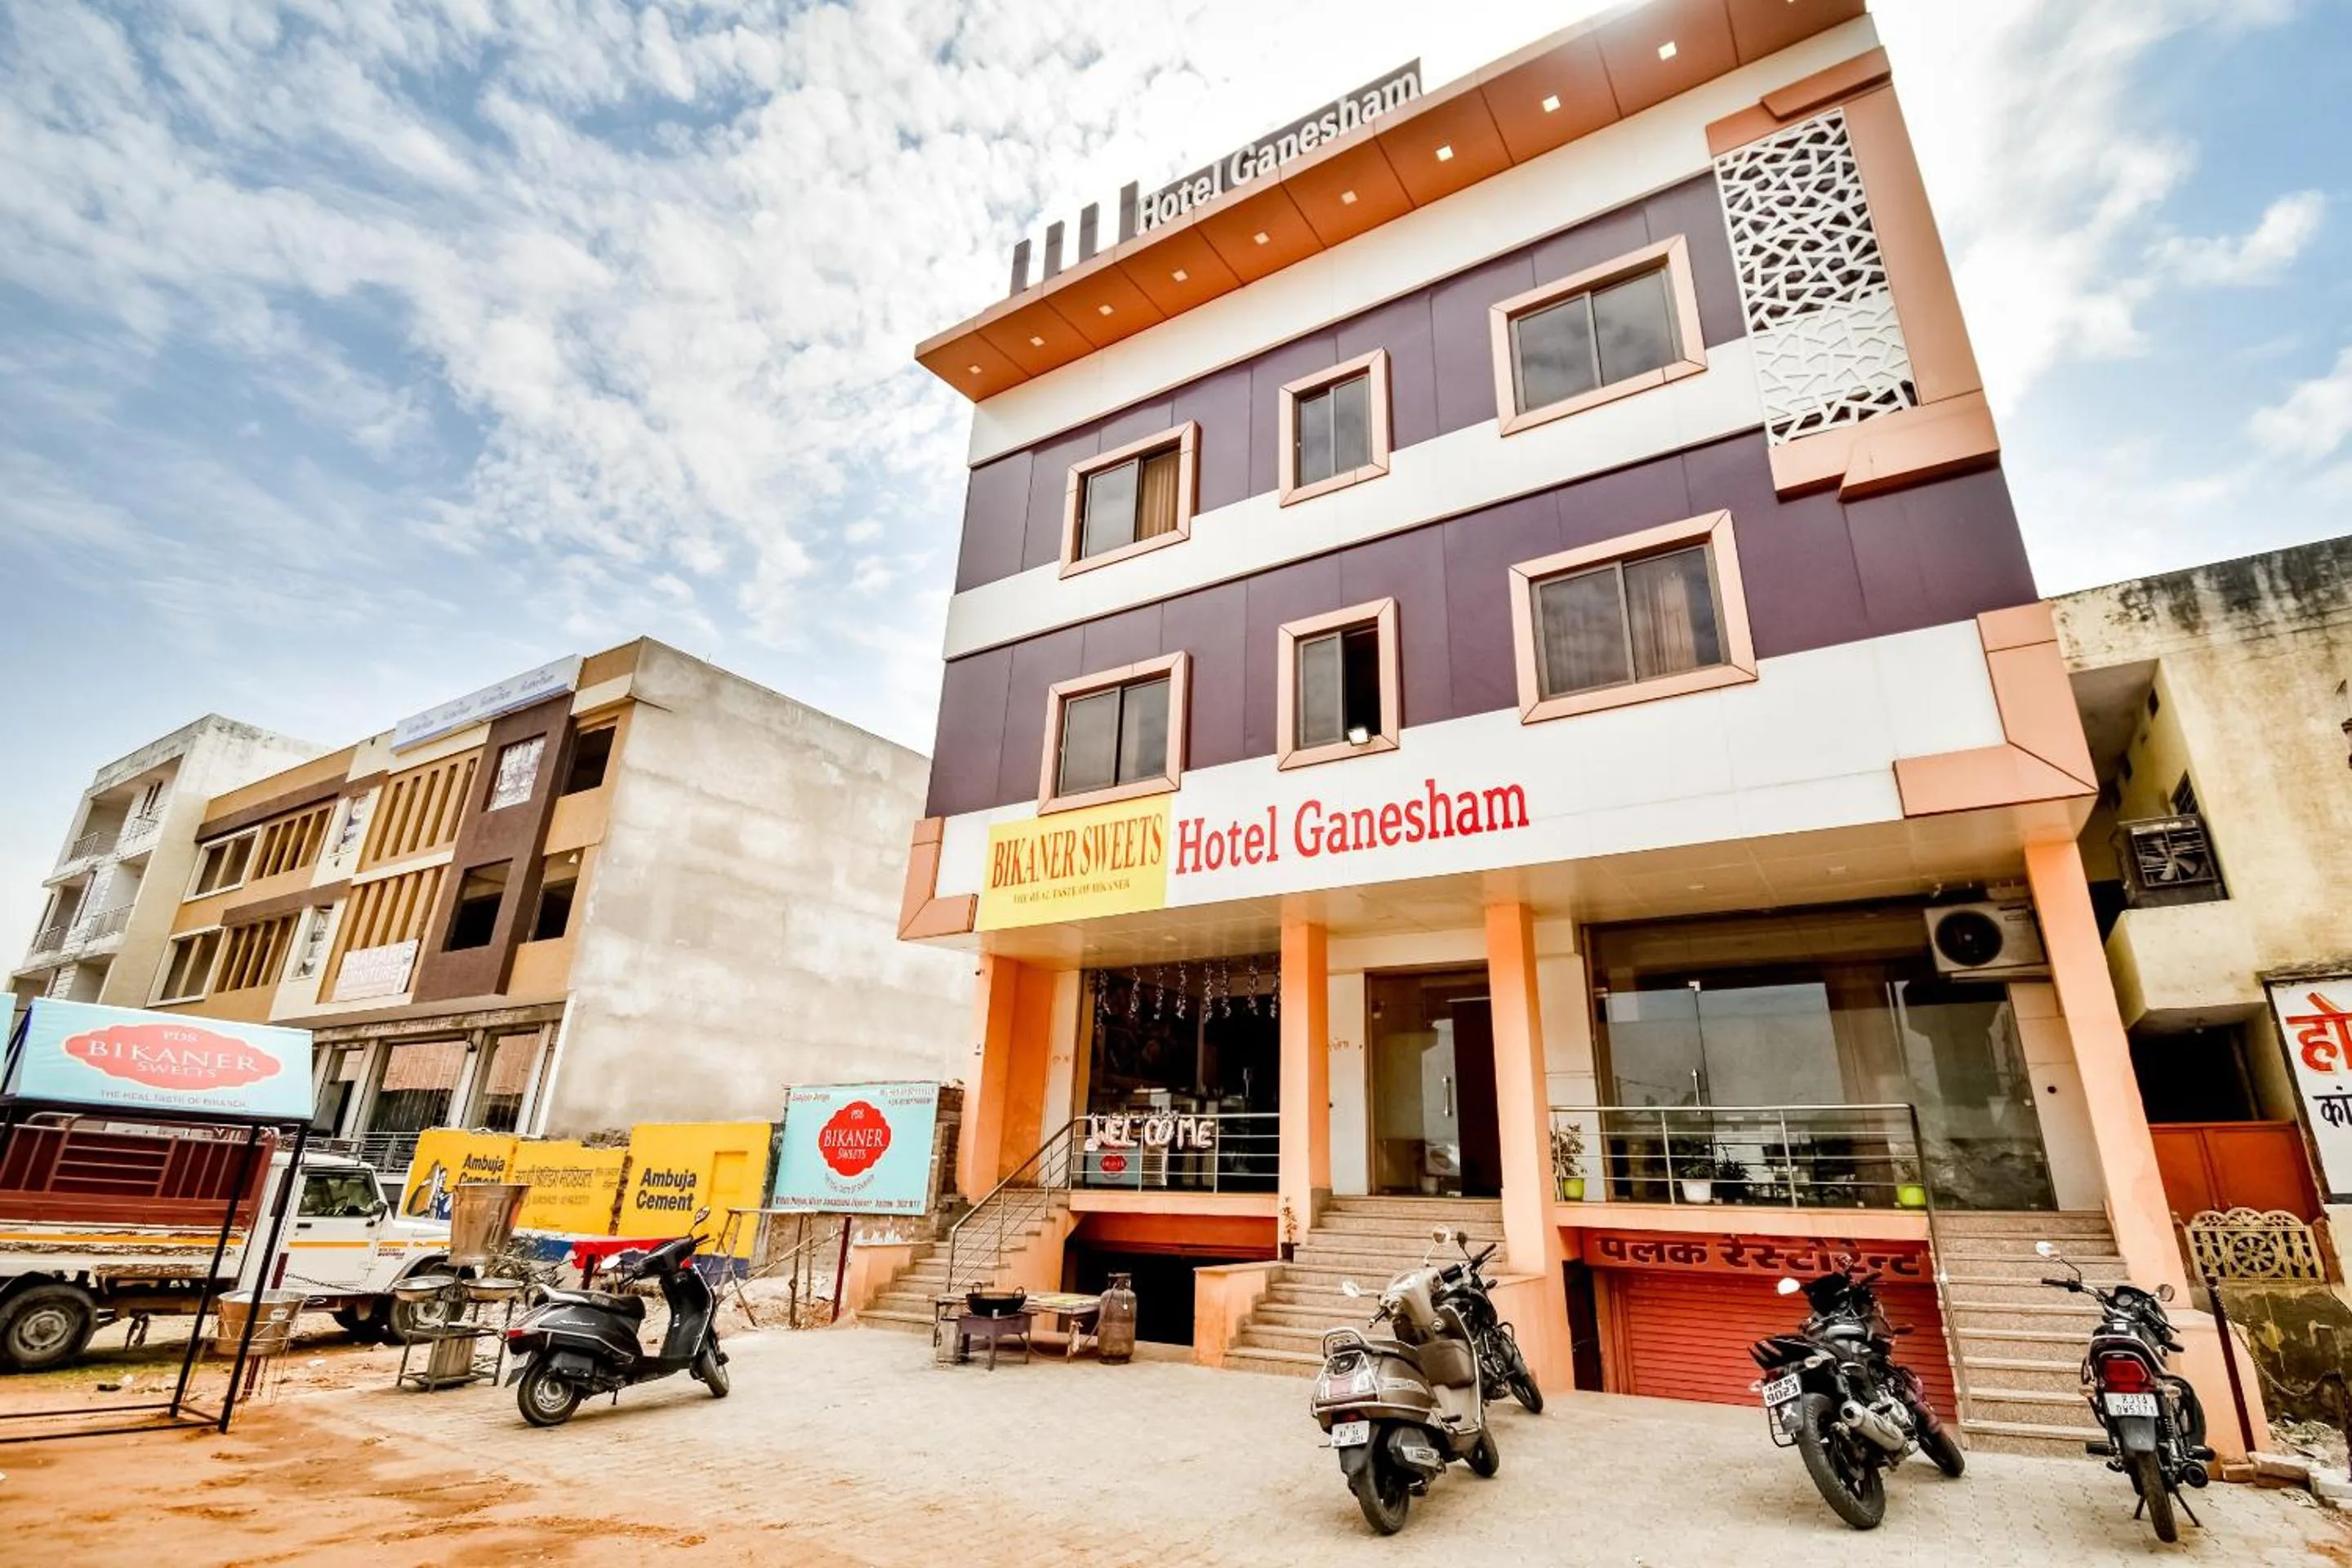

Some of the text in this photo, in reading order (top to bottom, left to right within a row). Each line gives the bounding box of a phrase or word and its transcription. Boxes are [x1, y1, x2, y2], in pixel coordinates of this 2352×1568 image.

[1136, 69, 1422, 236] Hotel Ganesham
[1175, 778, 1530, 875] Hotel Ganesham
[991, 813, 1164, 889] BIKANER SWEETS
[87, 1040, 261, 1072] BIKANER
[136, 1061, 217, 1079] SWEETS
[823, 1128, 884, 1147] BIKANER
[462, 1152, 506, 1175] Ambuja
[836, 1147, 866, 1160] SWEETS
[639, 1168, 697, 1196] Ambuja
[635, 1190, 693, 1212] Cement
[1596, 1236, 1708, 1265] पलक
